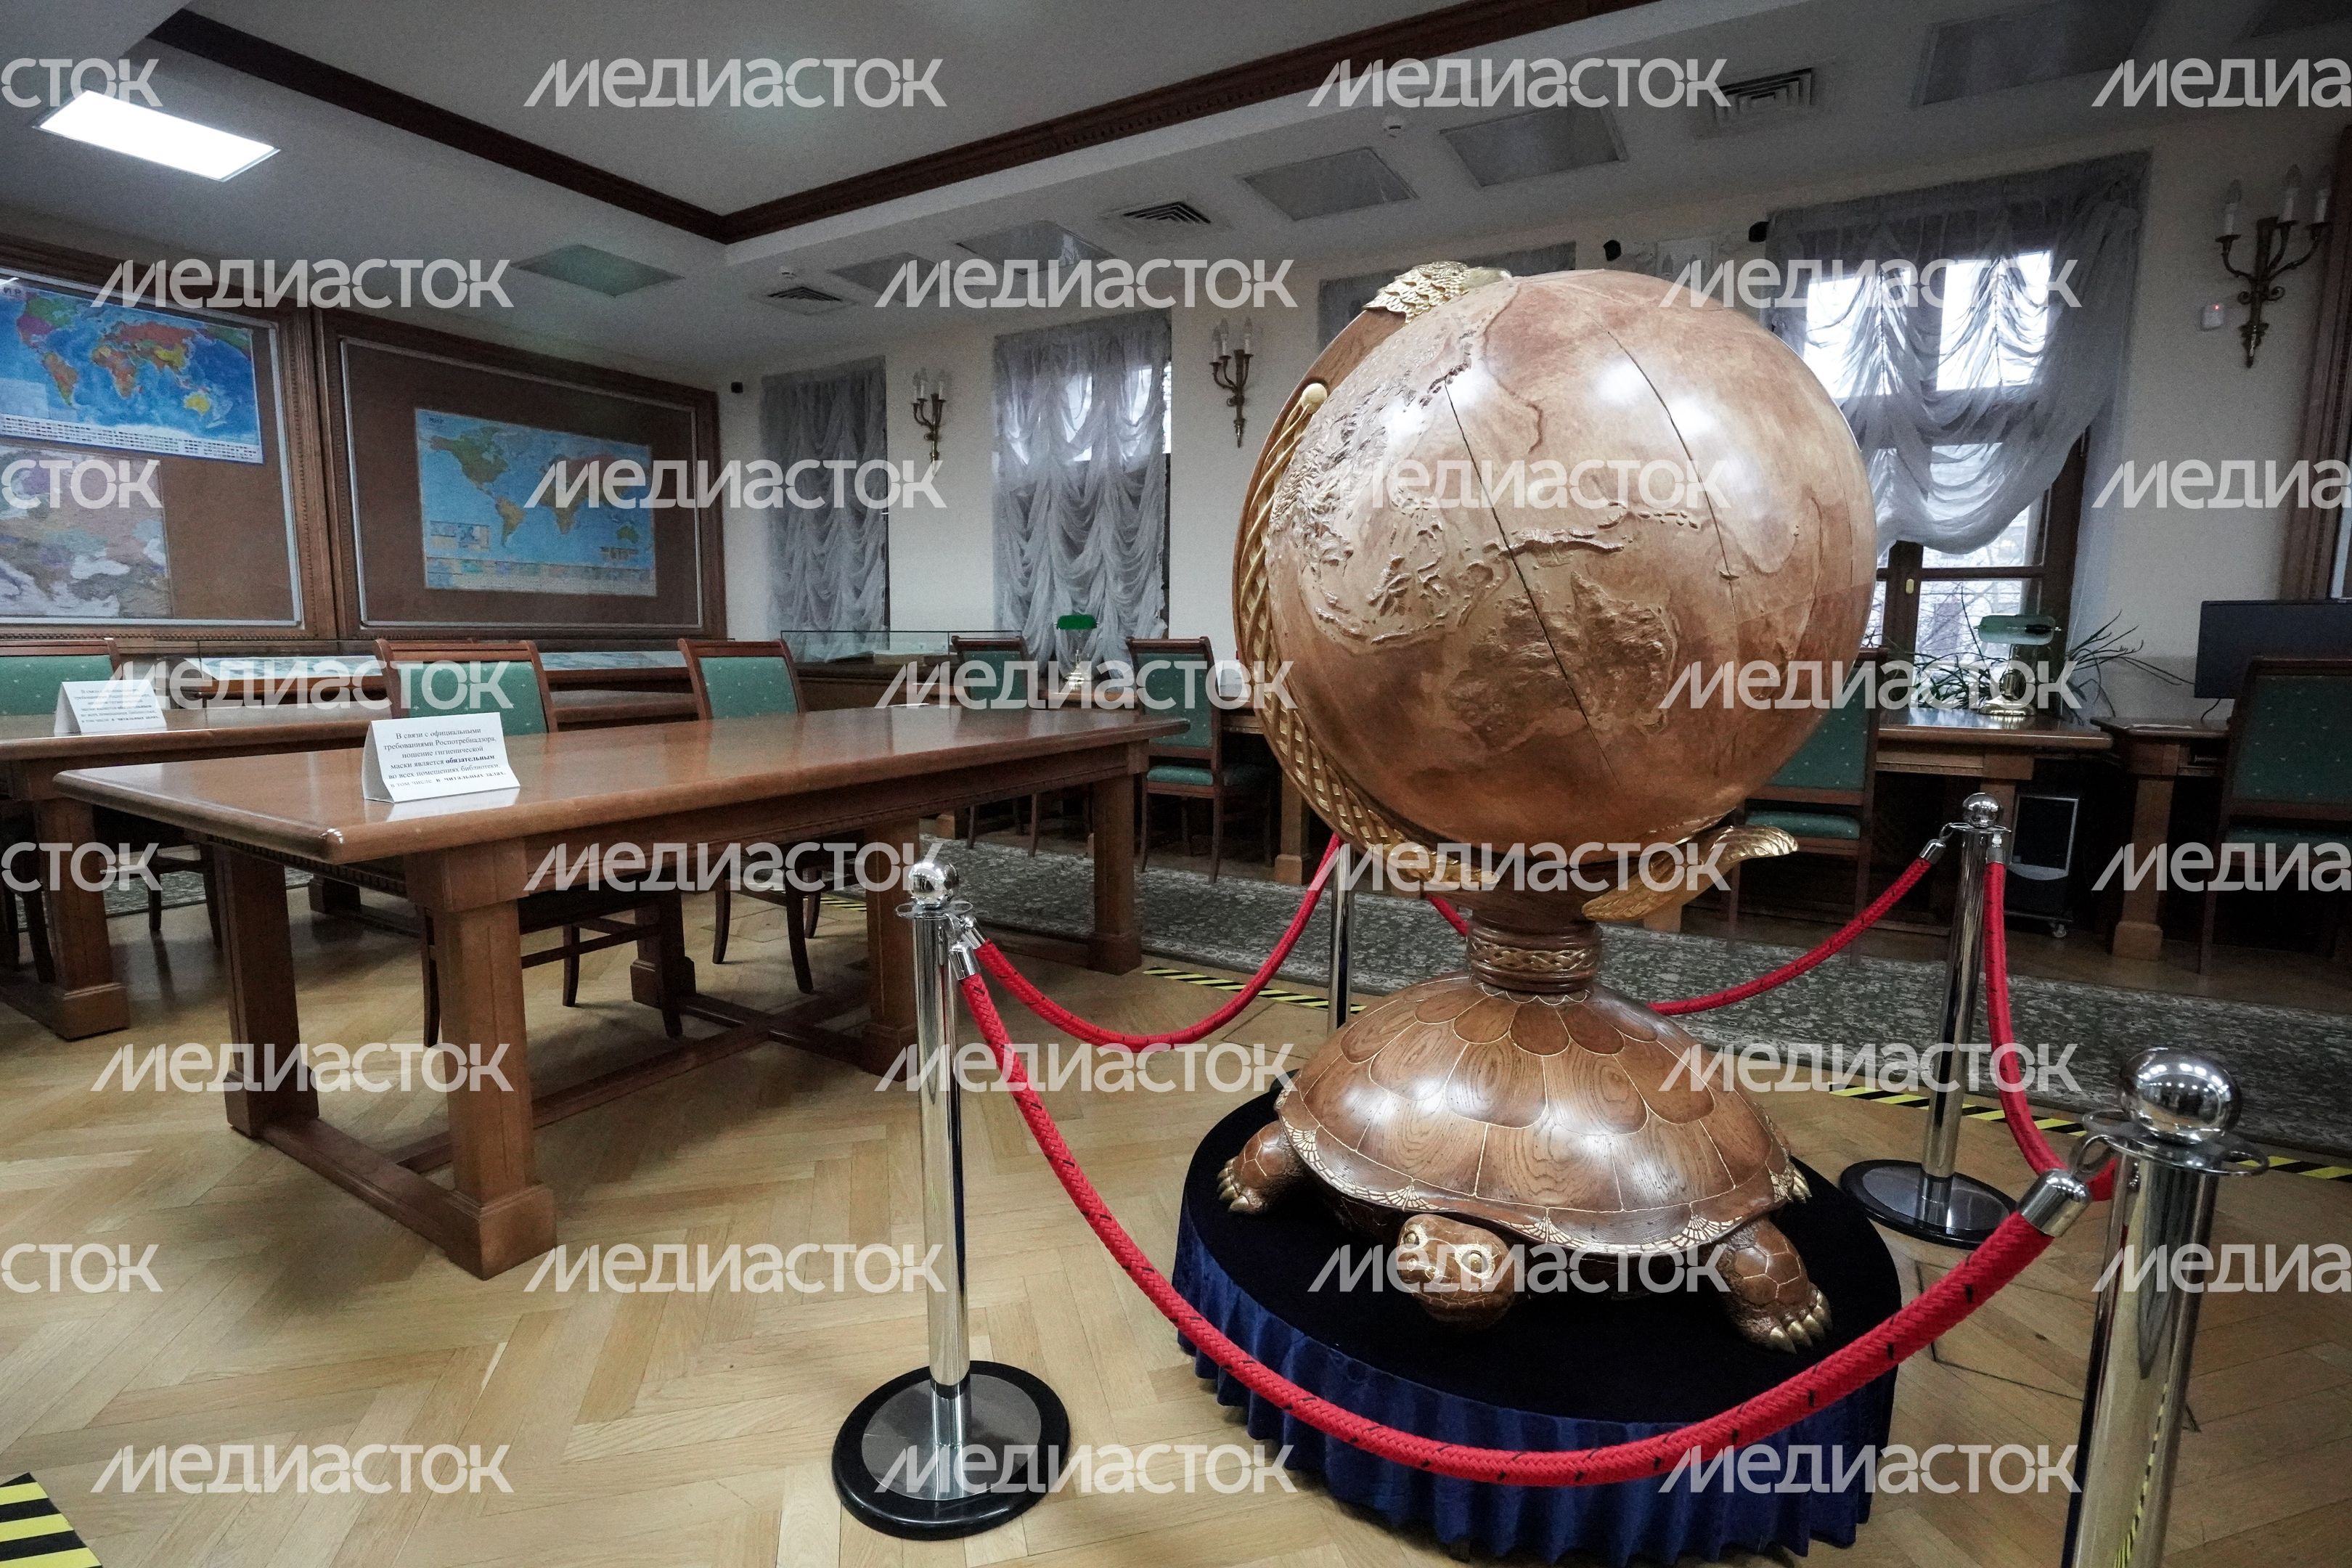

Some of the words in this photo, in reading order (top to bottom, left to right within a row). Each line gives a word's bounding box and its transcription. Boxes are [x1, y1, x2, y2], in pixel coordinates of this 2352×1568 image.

[429, 728, 482, 738] официальными
[383, 742, 434, 751] требованиями
[434, 746, 483, 756] гигиенической
[445, 755, 495, 764] обязательным
